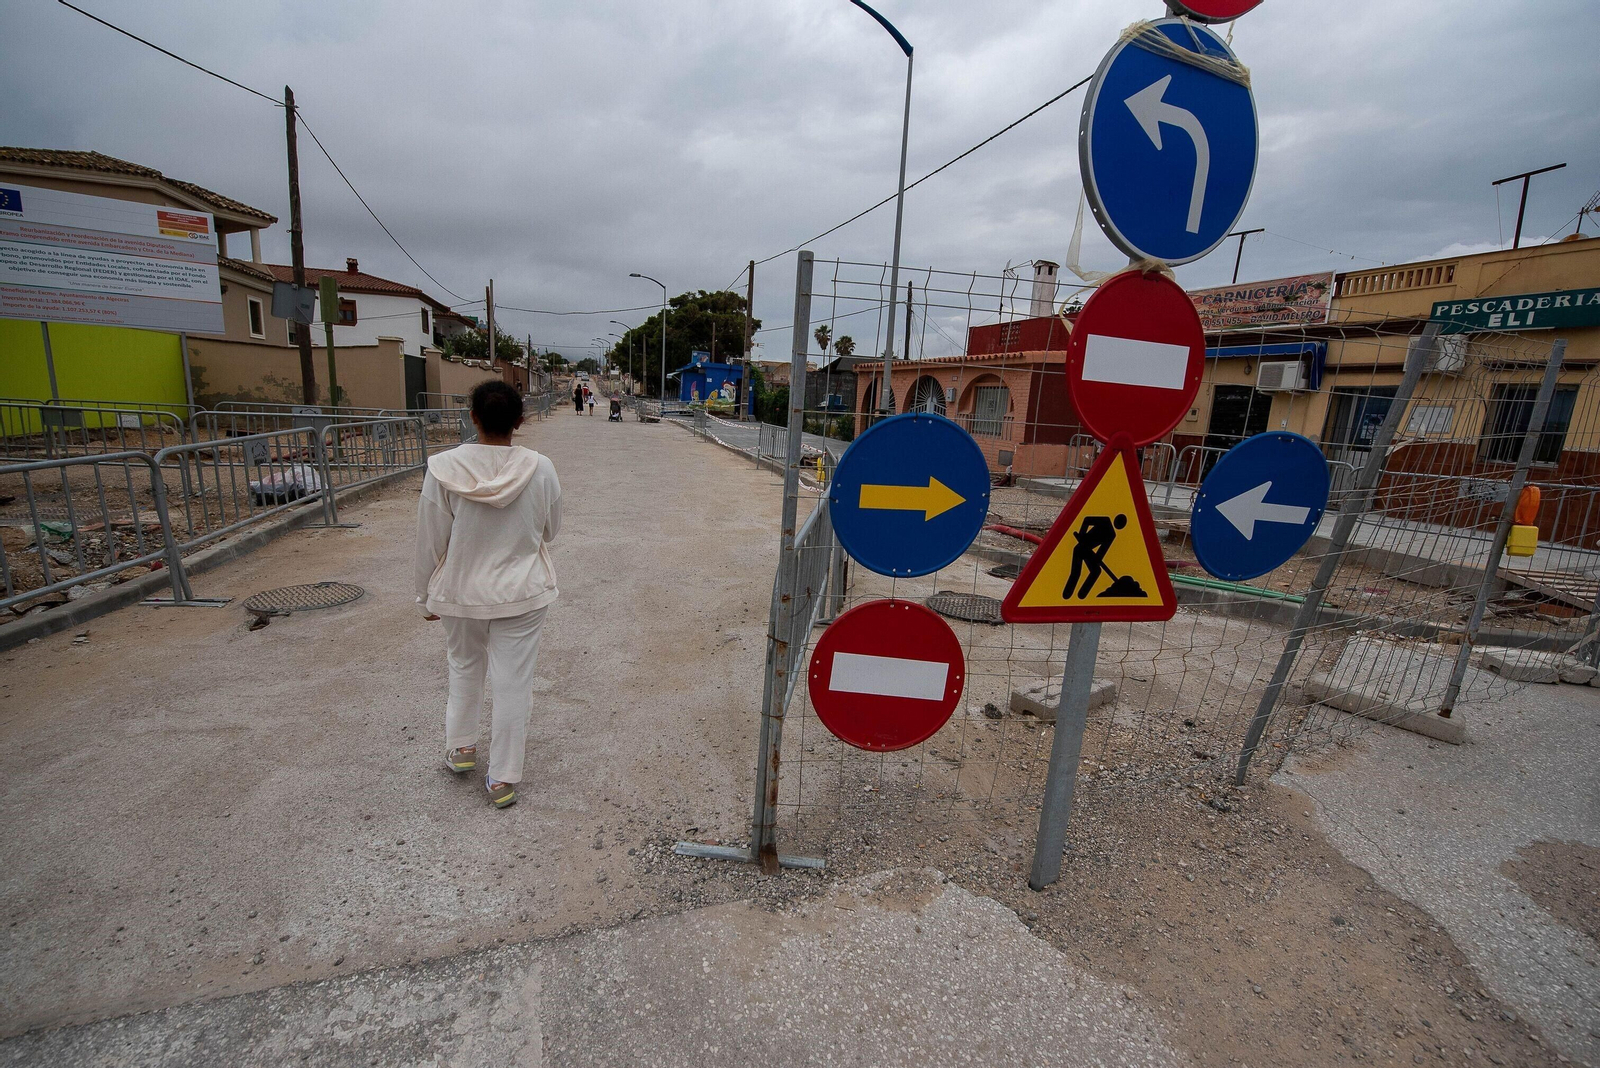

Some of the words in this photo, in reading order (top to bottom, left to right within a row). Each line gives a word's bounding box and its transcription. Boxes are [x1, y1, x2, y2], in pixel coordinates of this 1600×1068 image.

[20, 226, 65, 237] Reurbanización
[71, 232, 109, 242] reordenación
[20, 233, 60, 242] comprendido
[101, 243, 137, 251] Embarcadero
[170, 250, 195, 258] Mediana)
[22, 255, 62, 263] promovidos
[75, 260, 107, 268] Entidades
[132, 267, 170, 275] cofinanciada
[29, 261, 63, 269] Desarrollo
[64, 265, 92, 273] Regional
[92, 268, 117, 276] (FEDER)
[123, 272, 155, 280] gestionada
[87, 255, 109, 263] ayudas
[155, 262, 184, 270] Economía
[47, 269, 78, 277] conseguir
[92, 274, 124, 282] economía
[162, 281, 194, 289] sostenible.
[1, 294, 29, 302] Inversión
[59, 292, 98, 300] Ayuntamiento
[1202, 280, 1308, 305] CARNICERÍA
[1218, 305, 1252, 313] Verduras
[1259, 298, 1319, 310] Alimentación
[1435, 292, 1600, 317] PESCADERIA
[1211, 317, 1224, 326] 551
[1226, 316, 1242, 325] 455
[1488, 311, 1535, 328] ELI
